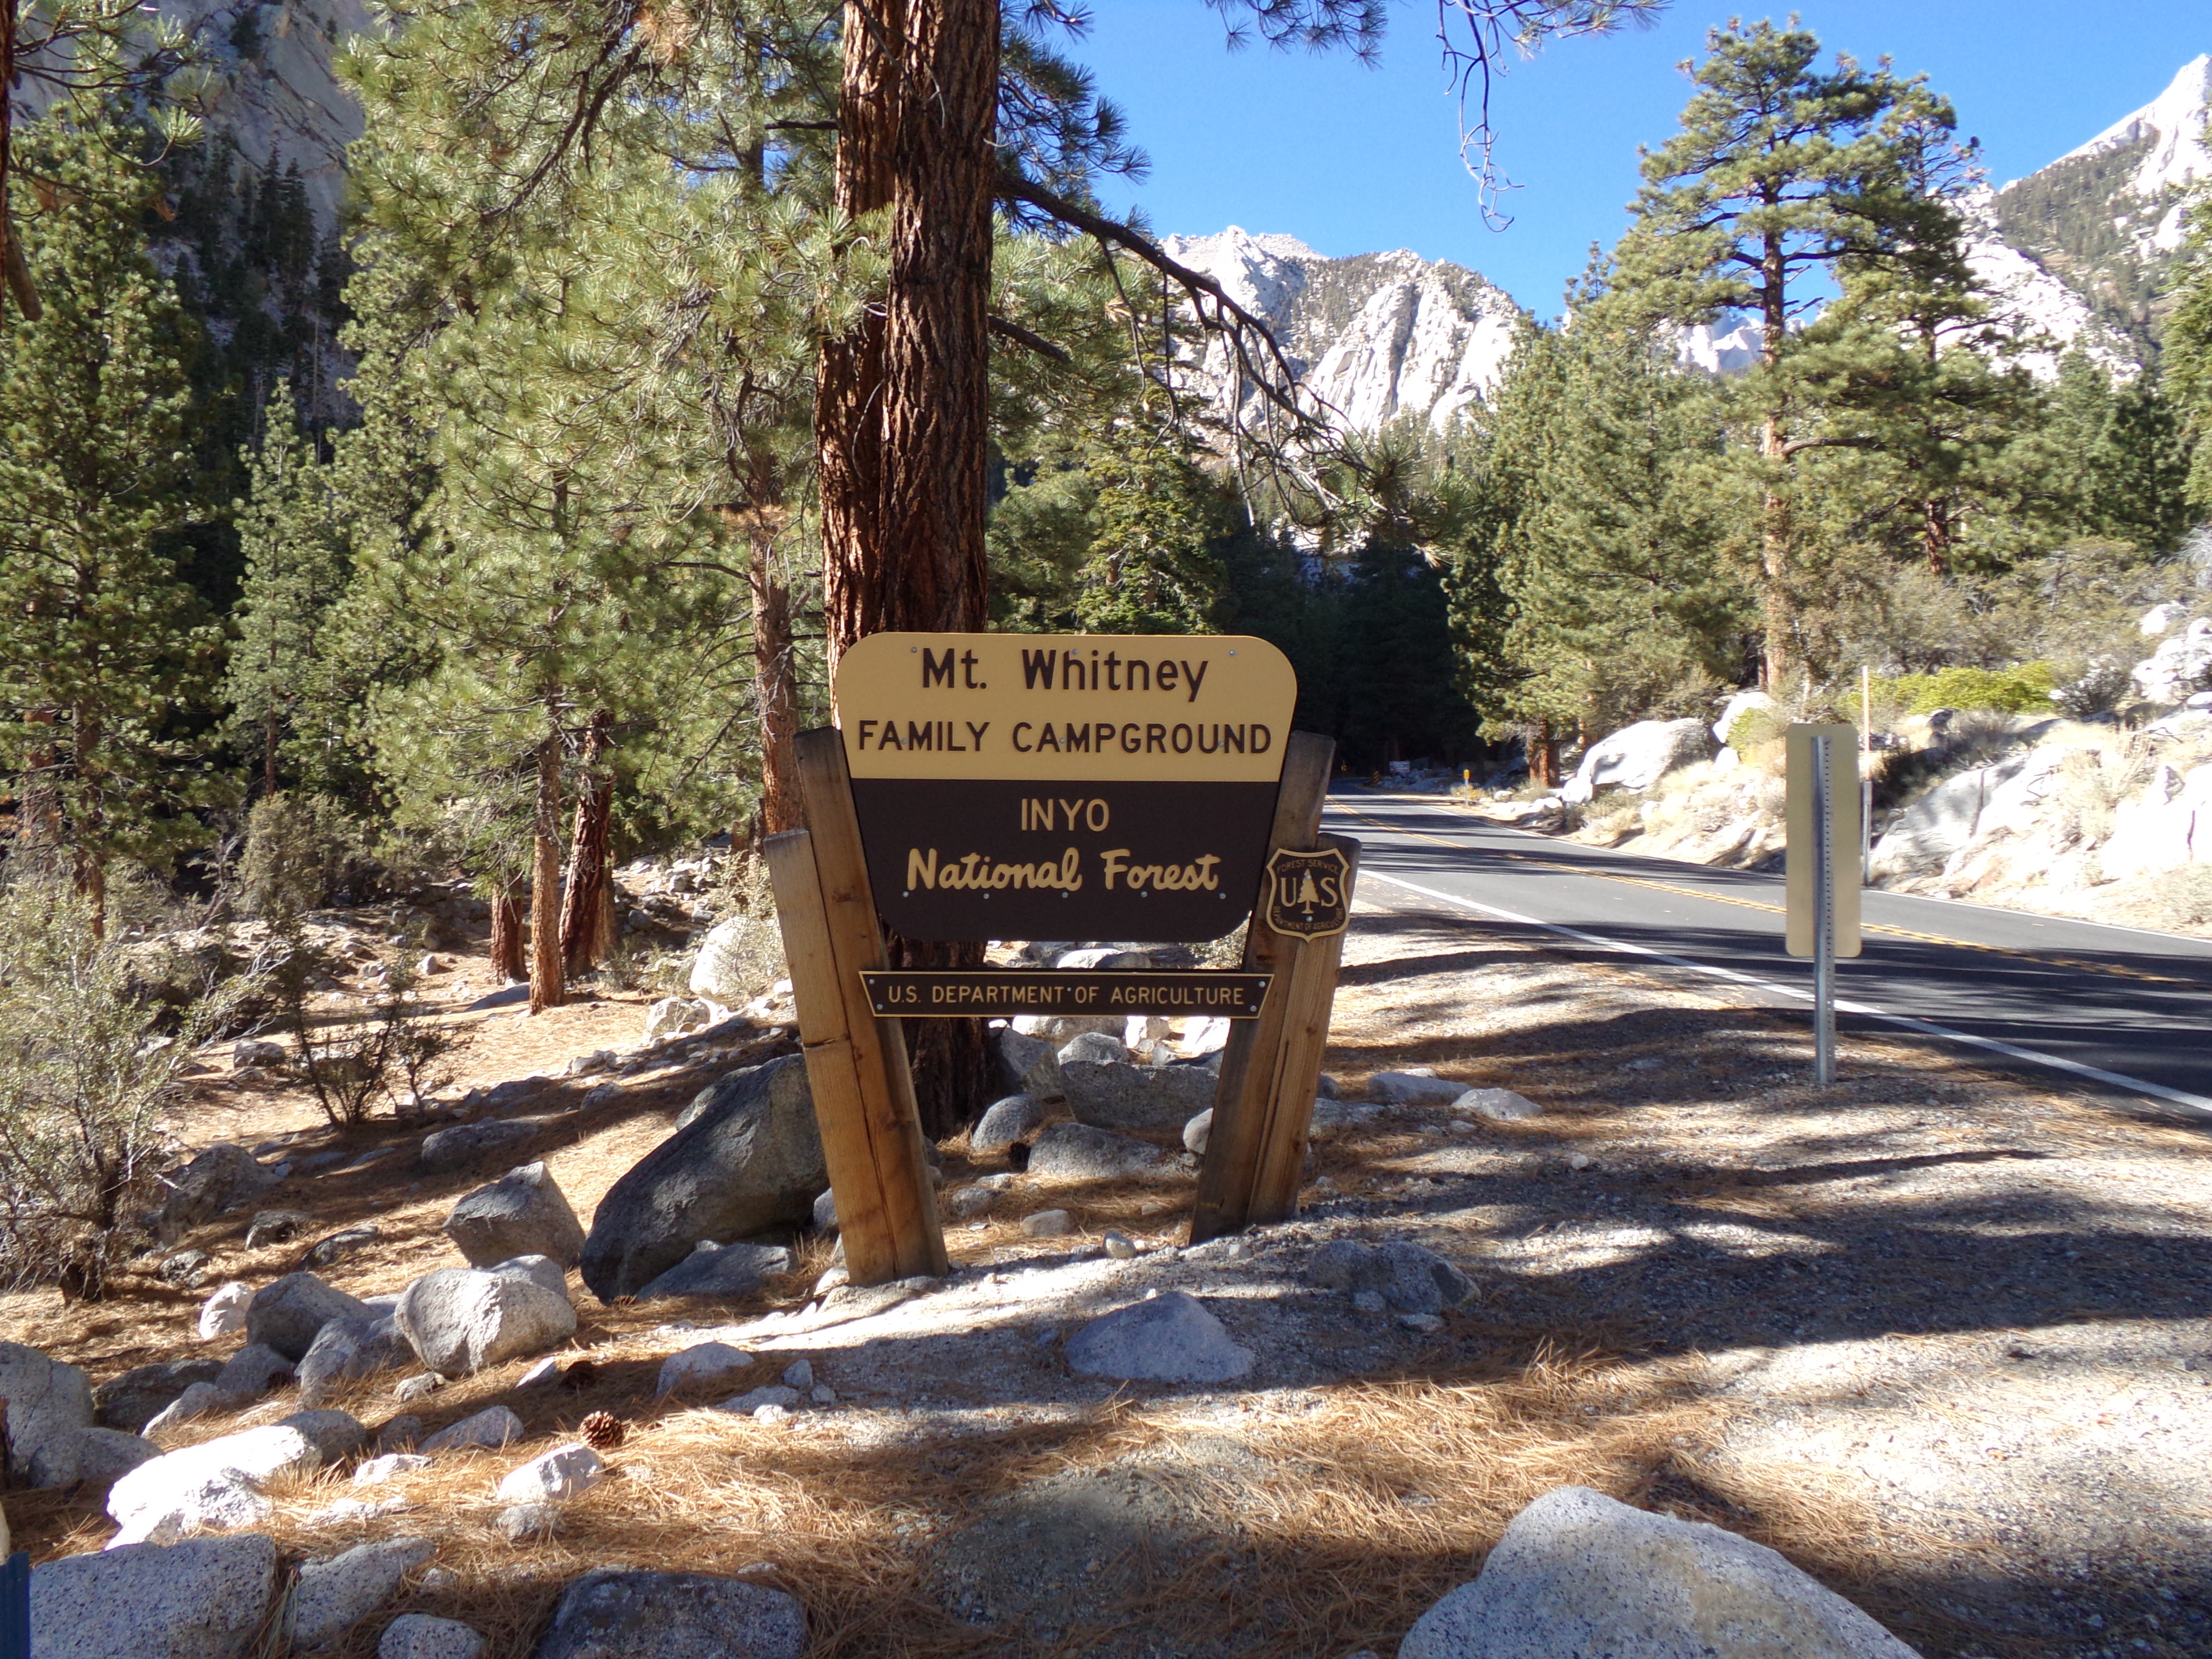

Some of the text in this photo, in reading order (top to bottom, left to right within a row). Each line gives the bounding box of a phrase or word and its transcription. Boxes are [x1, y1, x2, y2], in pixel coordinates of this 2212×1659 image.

[922, 648, 1209, 703] Mt. Whitney
[858, 720, 1272, 754] FAMILY CAMPGROUND
[1022, 798, 1109, 832] INYO
[907, 847, 1221, 891] National Forest
[1277, 859, 1338, 875] FOREST SERVICE
[888, 986, 1244, 1005] U.S. DEPARTMENT OF AGRICULTURE
